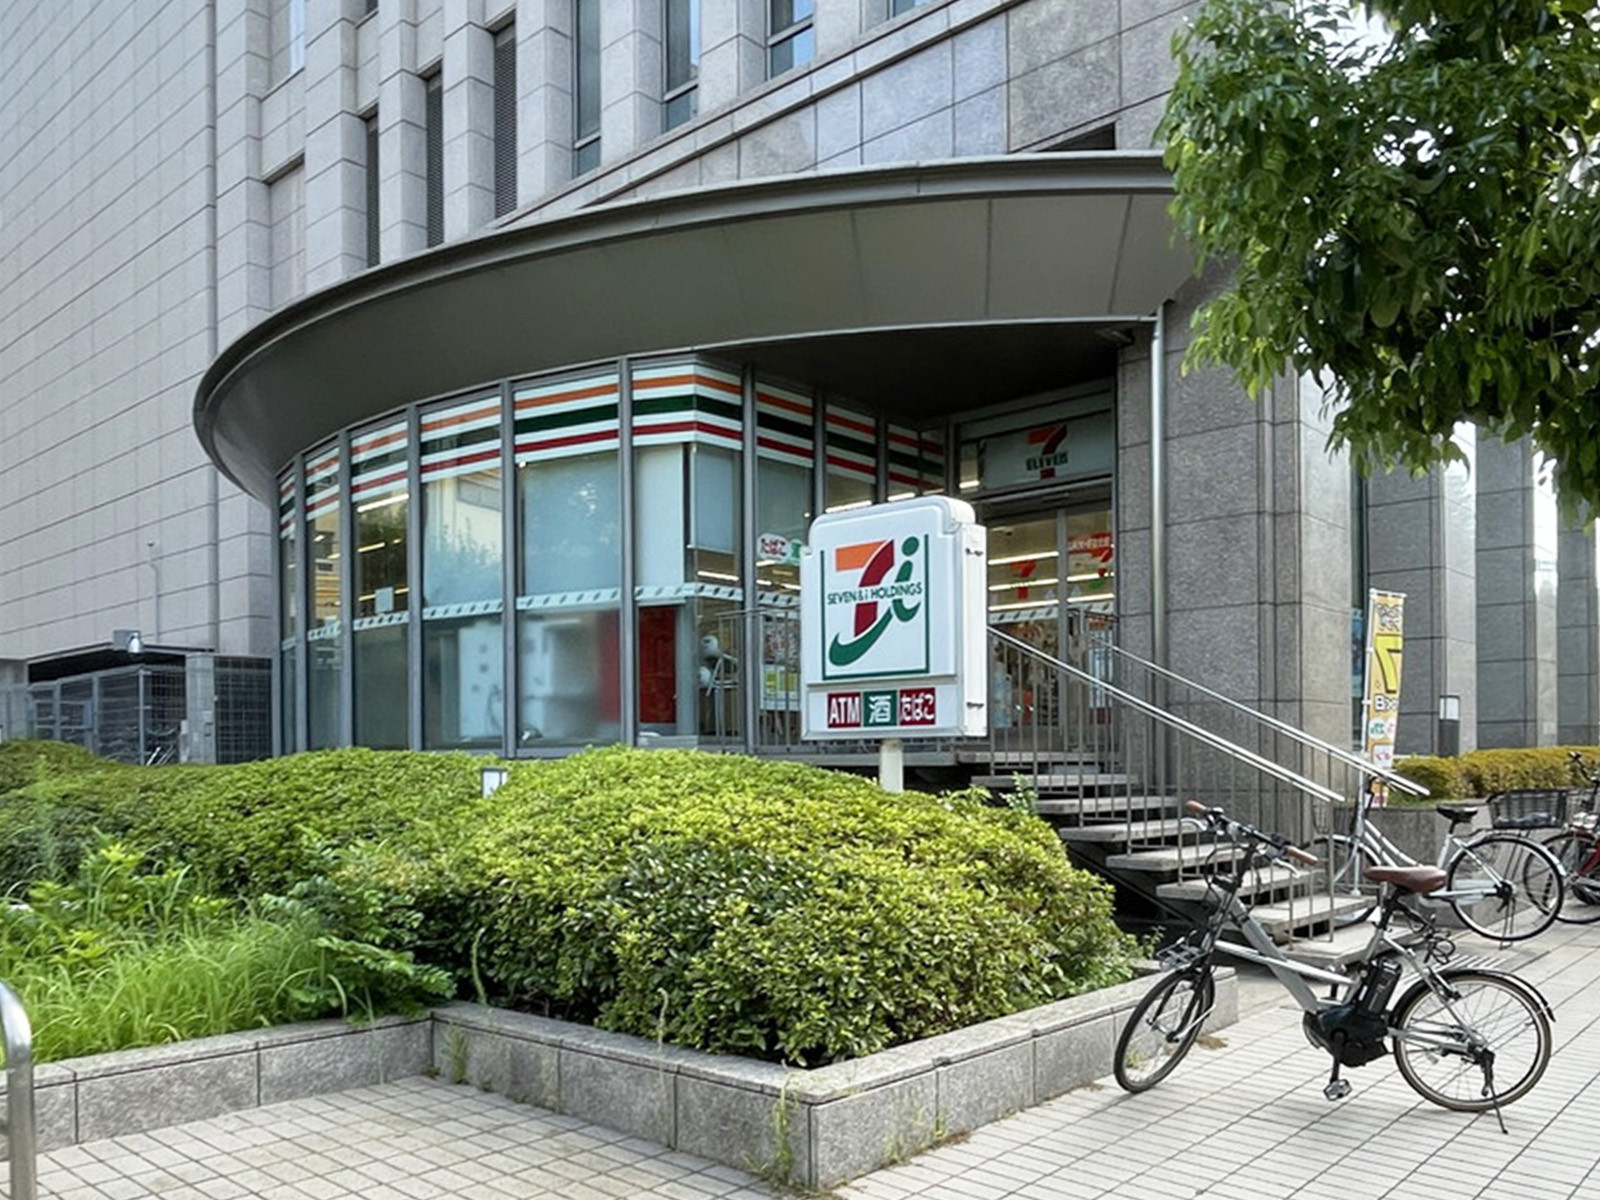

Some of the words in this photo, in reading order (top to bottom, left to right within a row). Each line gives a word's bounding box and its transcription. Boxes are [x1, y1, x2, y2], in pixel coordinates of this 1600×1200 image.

[870, 581, 923, 599] HOLDINGS
[829, 696, 860, 724] ATM
[868, 695, 892, 723] 酒
[901, 692, 935, 722] たばこ
